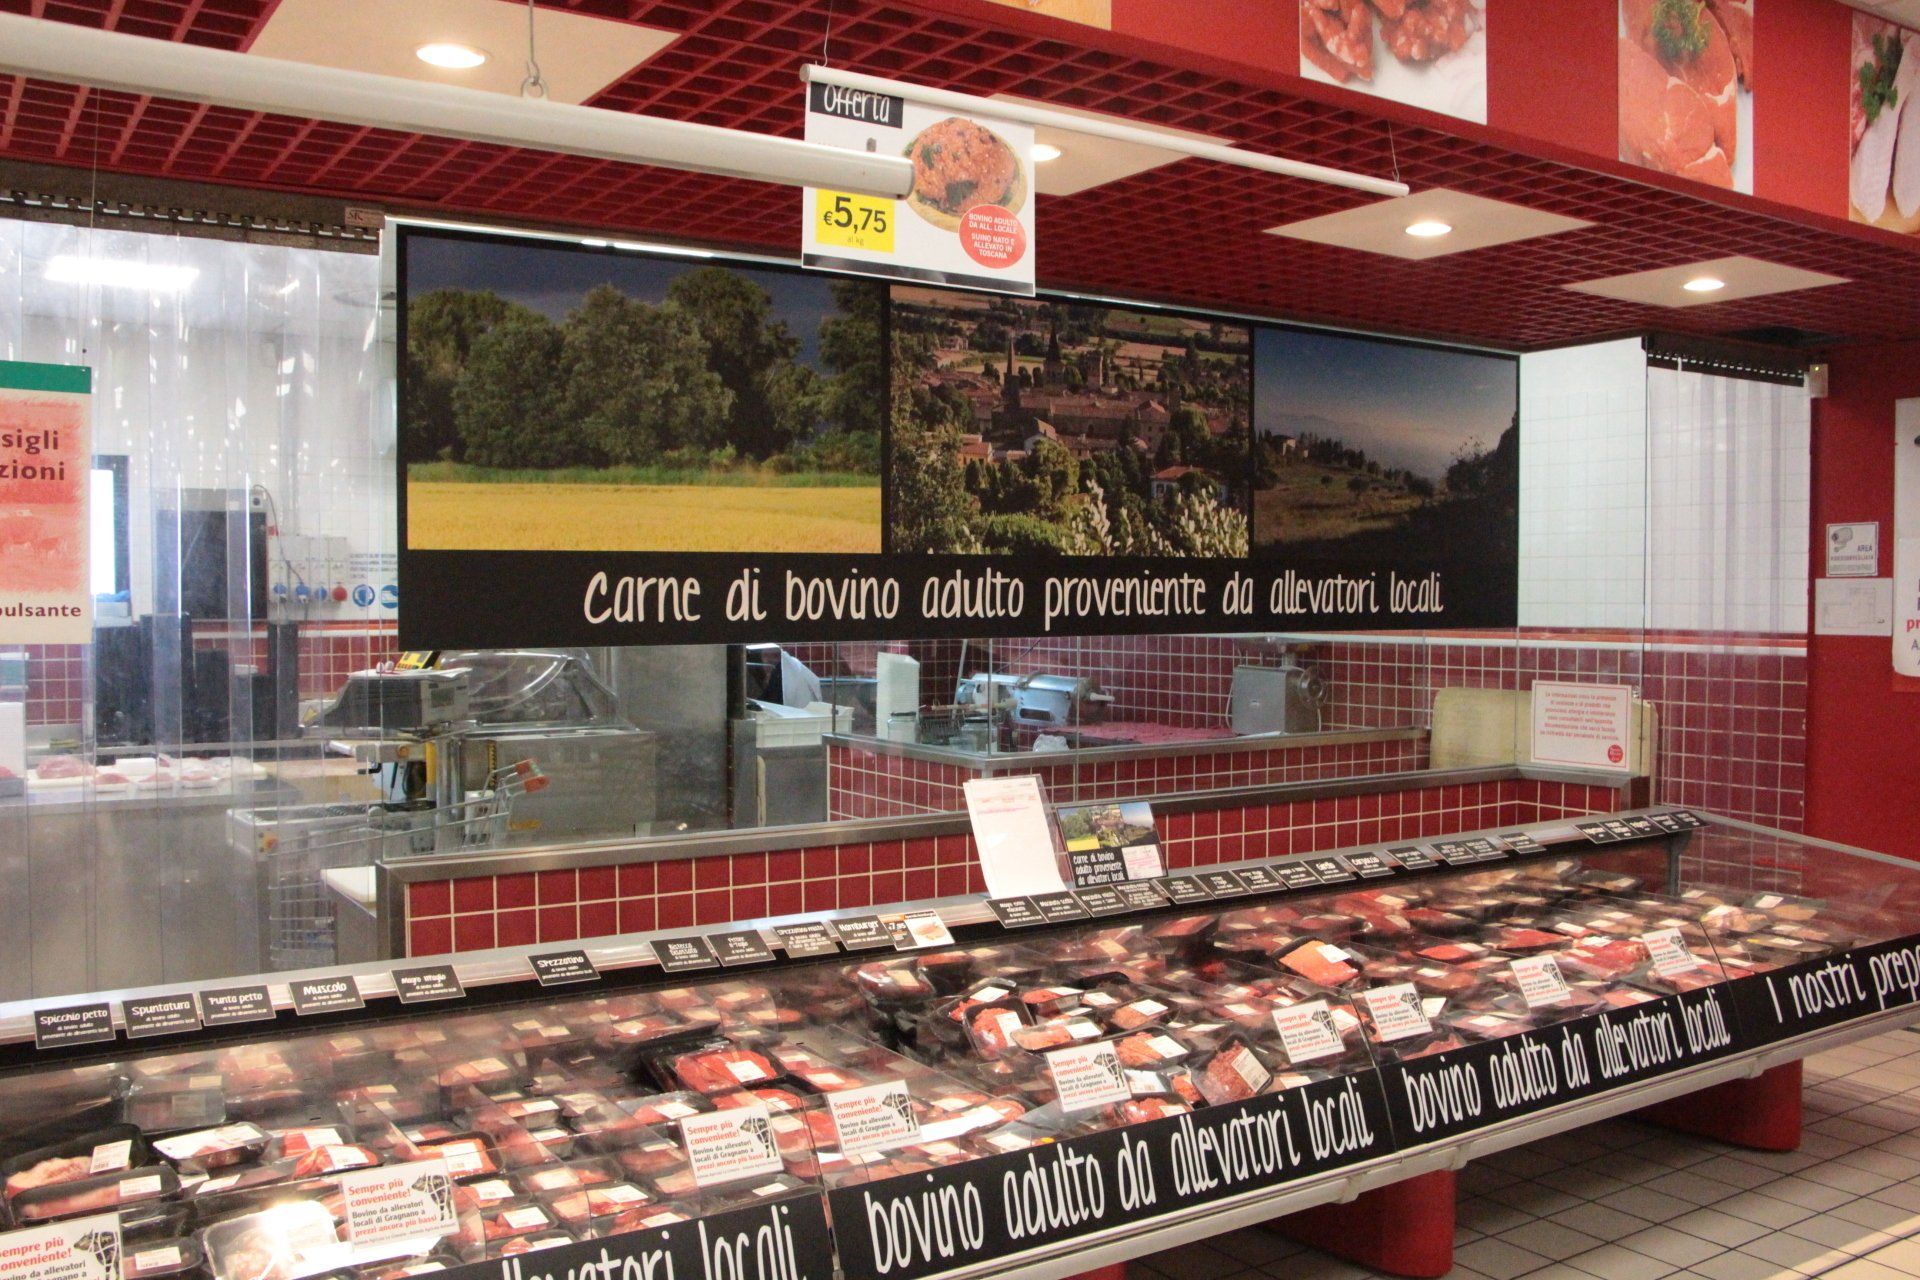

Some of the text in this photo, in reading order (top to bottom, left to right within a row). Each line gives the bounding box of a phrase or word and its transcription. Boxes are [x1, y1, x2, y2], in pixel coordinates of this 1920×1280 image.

[823, 83, 890, 123] Offerta
[823, 196, 887, 234] €5,75
[968, 213, 1018, 226] BOVINO ADULTO
[968, 220, 1017, 234] DA ALL. LOCALE
[855, 236, 865, 247] kg
[971, 233, 992, 241] SUINO
[992, 235, 1010, 244] NATO
[974, 241, 1005, 251] ALLEVATO
[978, 249, 1008, 259] TOSCANA
[1857, 544, 1873, 552] AREA
[583, 567, 1444, 632] Carne di bovino adulto proveniente da allevatori locali
[1073, 851, 1115, 865] Carne di bovino
[1075, 865, 1093, 875] adulto
[1093, 861, 1123, 874] proveniente
[1078, 872, 1126, 886] da allevatori locali
[536, 955, 585, 969] Spezzatino
[303, 981, 348, 996] Muscolo
[1766, 976, 1784, 1024] I
[1789, 952, 1867, 1017] nostri
[208, 992, 263, 1006] Punta petto
[131, 1000, 190, 1017] Spuntatura
[39, 1009, 108, 1026] Spicchio petto
[1052, 1055, 1088, 1067] Sempre più
[1399, 989, 1732, 1133] bovino adulto da allevatori locali
[1055, 1063, 1095, 1077] conveniente!
[833, 1096, 876, 1111] Sempre più
[837, 1104, 882, 1120] conveniente!
[687, 1120, 733, 1136] Sempre più
[839, 1114, 894, 1130] Bovino da allevatori
[841, 1129, 858, 1137] locali
[864, 1123, 891, 1133] Gragnano
[690, 1129, 740, 1146] conveniente!
[843, 1136, 861, 1145] prezzi
[881, 1130, 891, 1138] più
[891, 1126, 906, 1134] bassi
[692, 1146, 714, 1156] Bovino
[724, 1139, 752, 1150] allevatori
[694, 1154, 712, 1164] locali
[712, 1152, 719, 1160] di
[720, 1149, 749, 1159] Gragnano
[696, 1162, 715, 1172] prezzi
[737, 1156, 748, 1164] più
[748, 1152, 765, 1160] bassi
[863, 1075, 1375, 1275] bovino adulto da allevatori locali
[348, 1178, 404, 1196] Sempre più
[350, 1188, 411, 1208] conveniente!
[352, 1199, 424, 1219] Bovino da allevatori
[353, 1217, 373, 1228] locali
[375, 1215, 383, 1224] di
[384, 1211, 419, 1223] Gragnano
[355, 1215, 437, 1238] prezzi ancora più bassi
[45, 1236, 64, 1251] più
[29, 1270, 41, 1278] da
[44, 1259, 86, 1276] allevatori
